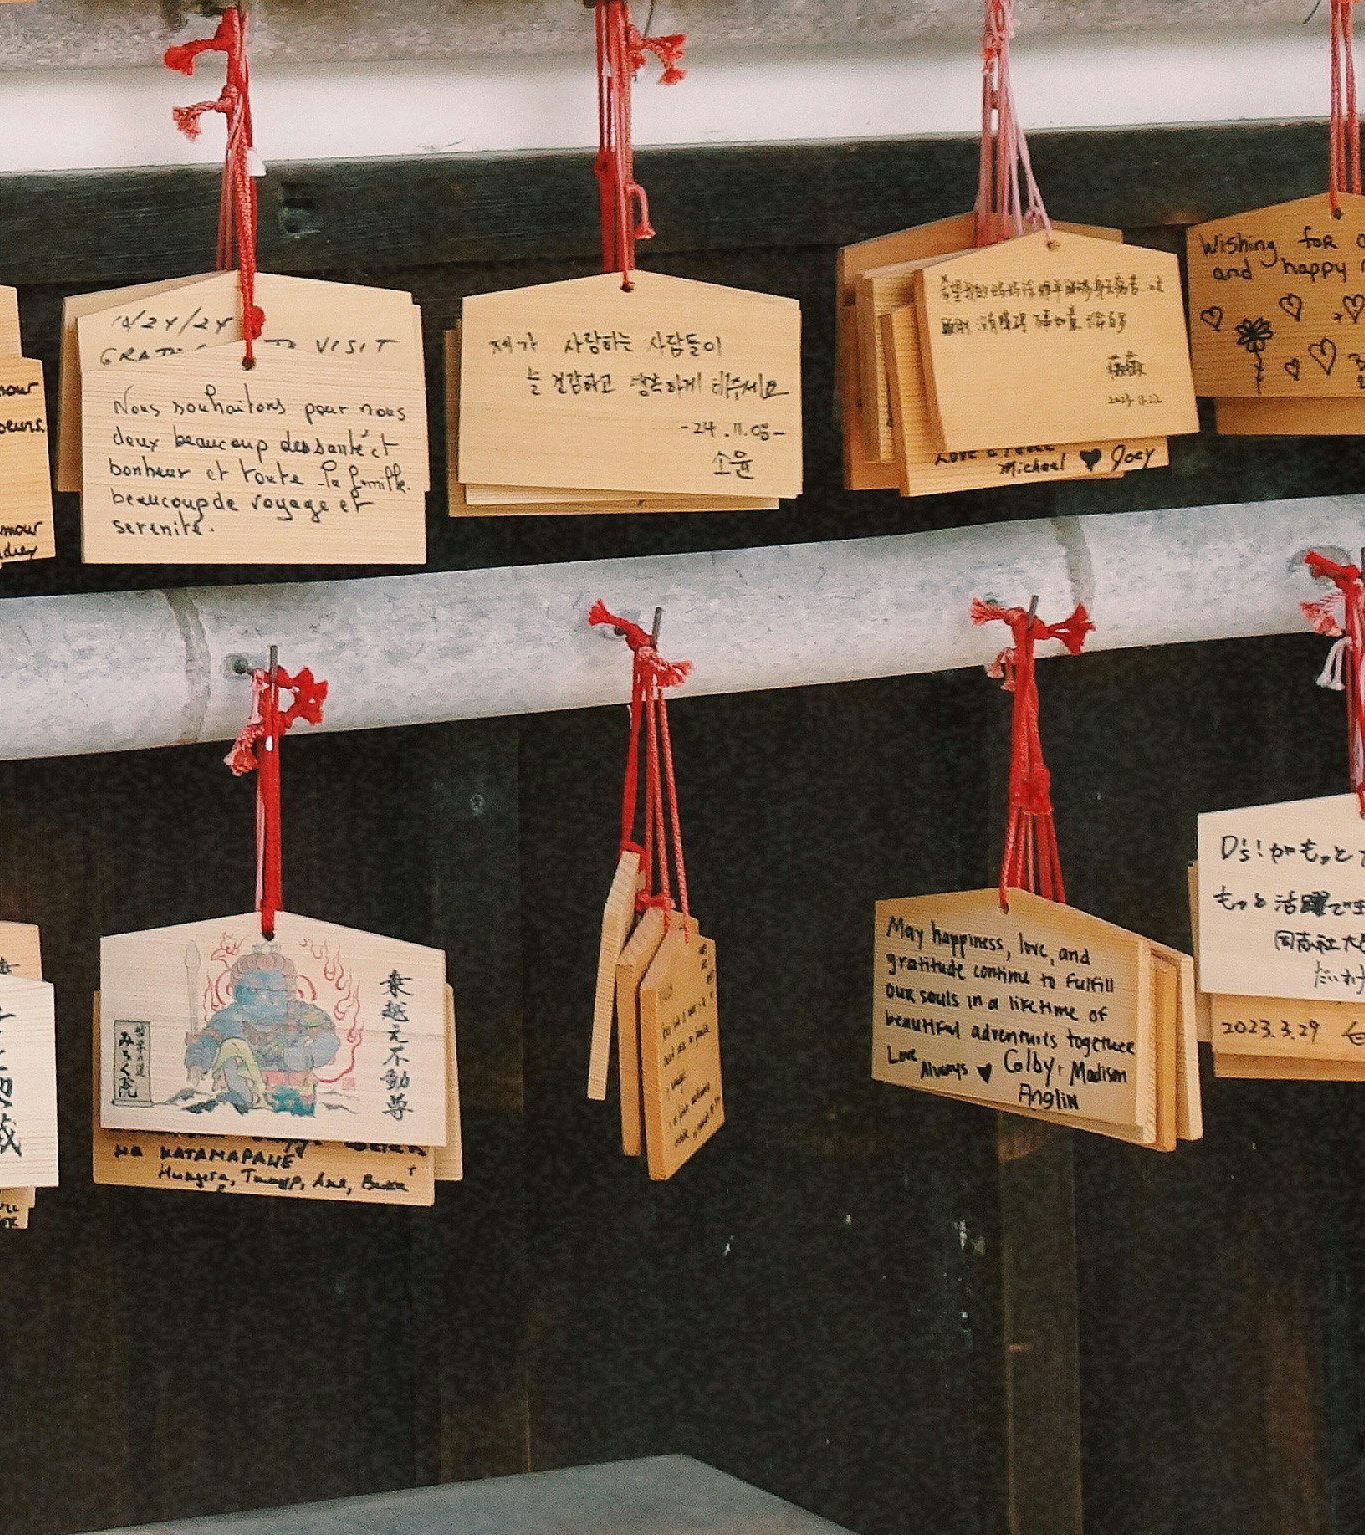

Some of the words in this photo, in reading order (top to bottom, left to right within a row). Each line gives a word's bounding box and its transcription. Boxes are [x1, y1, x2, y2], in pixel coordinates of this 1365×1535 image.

[1198, 232, 1279, 269] Wishing
[1212, 258, 1253, 282] and
[1280, 257, 1347, 283] happy
[304, 402, 349, 425] pour
[358, 403, 406, 422] nous
[885, 915, 924, 950] May
[1058, 947, 1091, 966] and
[919, 989, 960, 1008] souls
